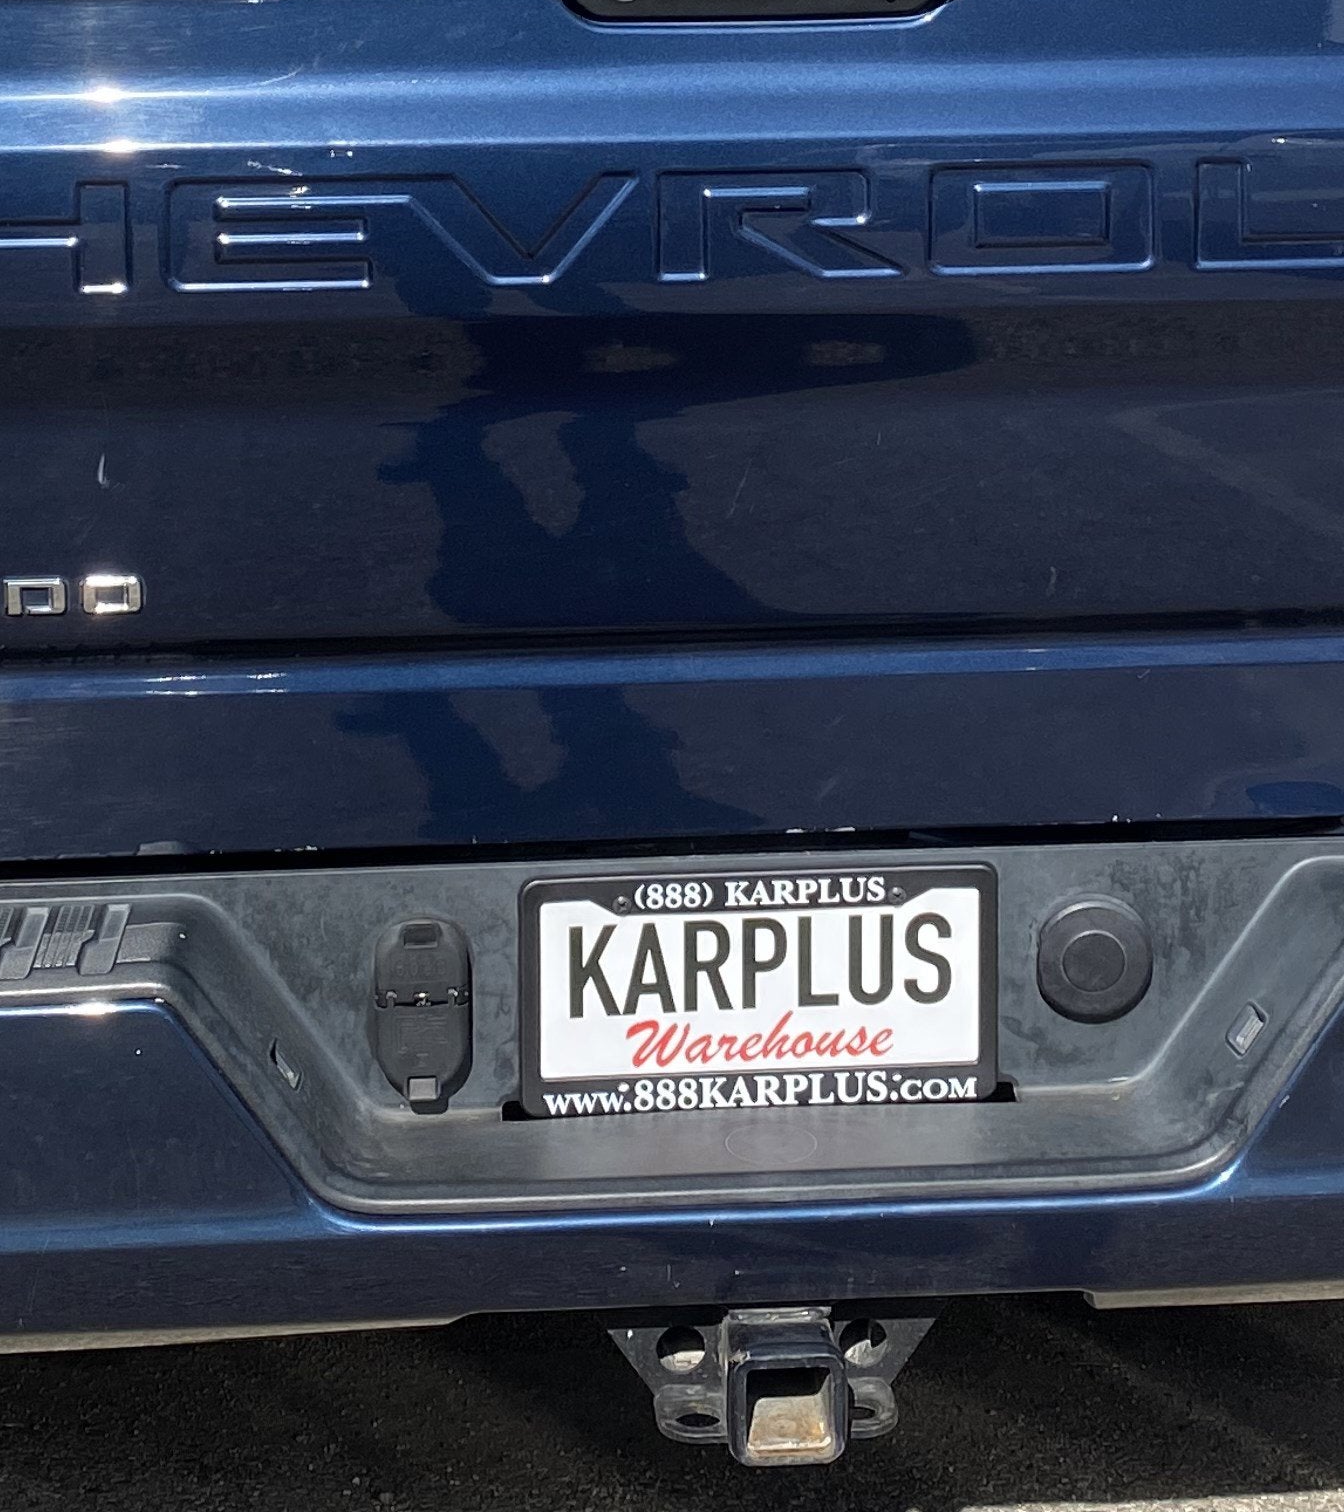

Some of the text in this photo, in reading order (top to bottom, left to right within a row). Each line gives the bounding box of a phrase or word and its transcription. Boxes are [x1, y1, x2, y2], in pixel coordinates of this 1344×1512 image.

[633, 875, 886, 911] (888) KARPLUS
[568, 911, 953, 1019] KARPLUS
[624, 1010, 894, 1068] Warehouse
